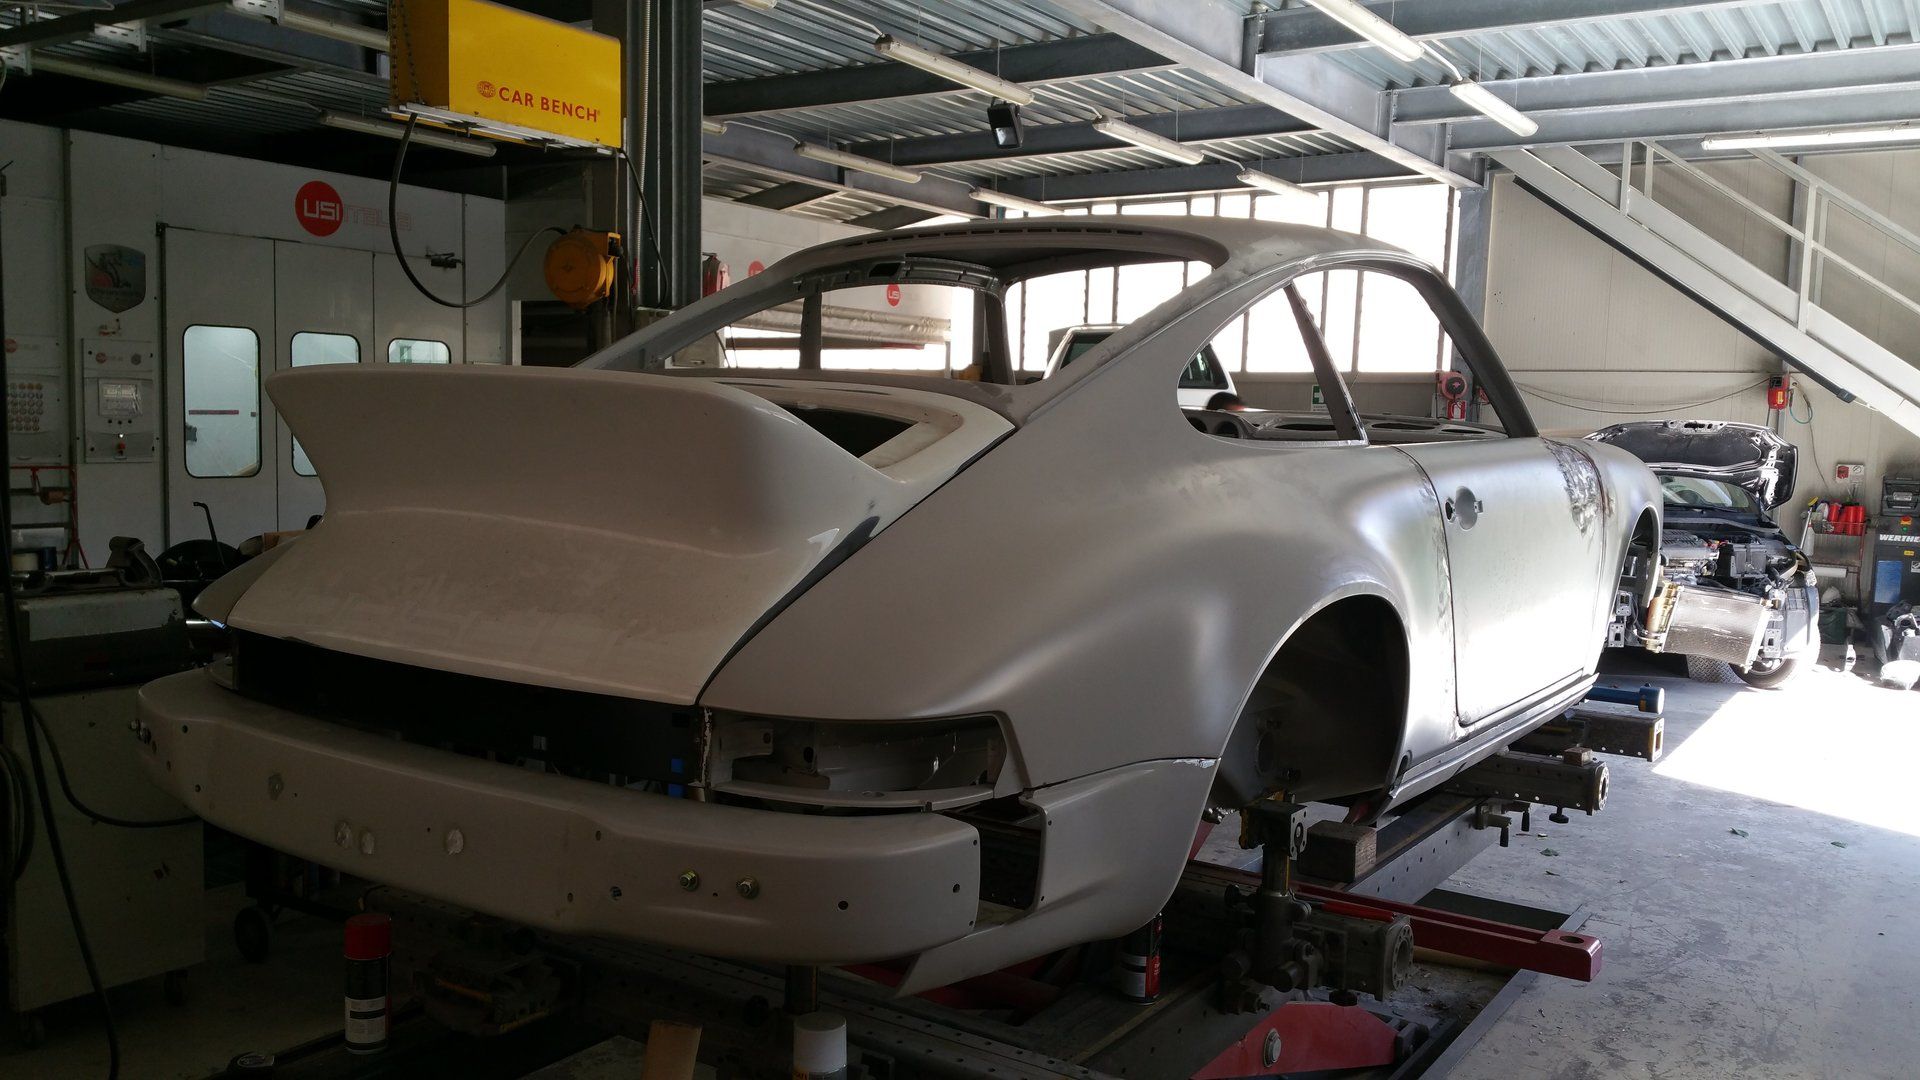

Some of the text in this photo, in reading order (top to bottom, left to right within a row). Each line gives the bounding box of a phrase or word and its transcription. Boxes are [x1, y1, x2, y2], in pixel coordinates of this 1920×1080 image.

[498, 87, 534, 108] CAR
[540, 96, 597, 122] BENCH
[304, 199, 339, 221] USI
